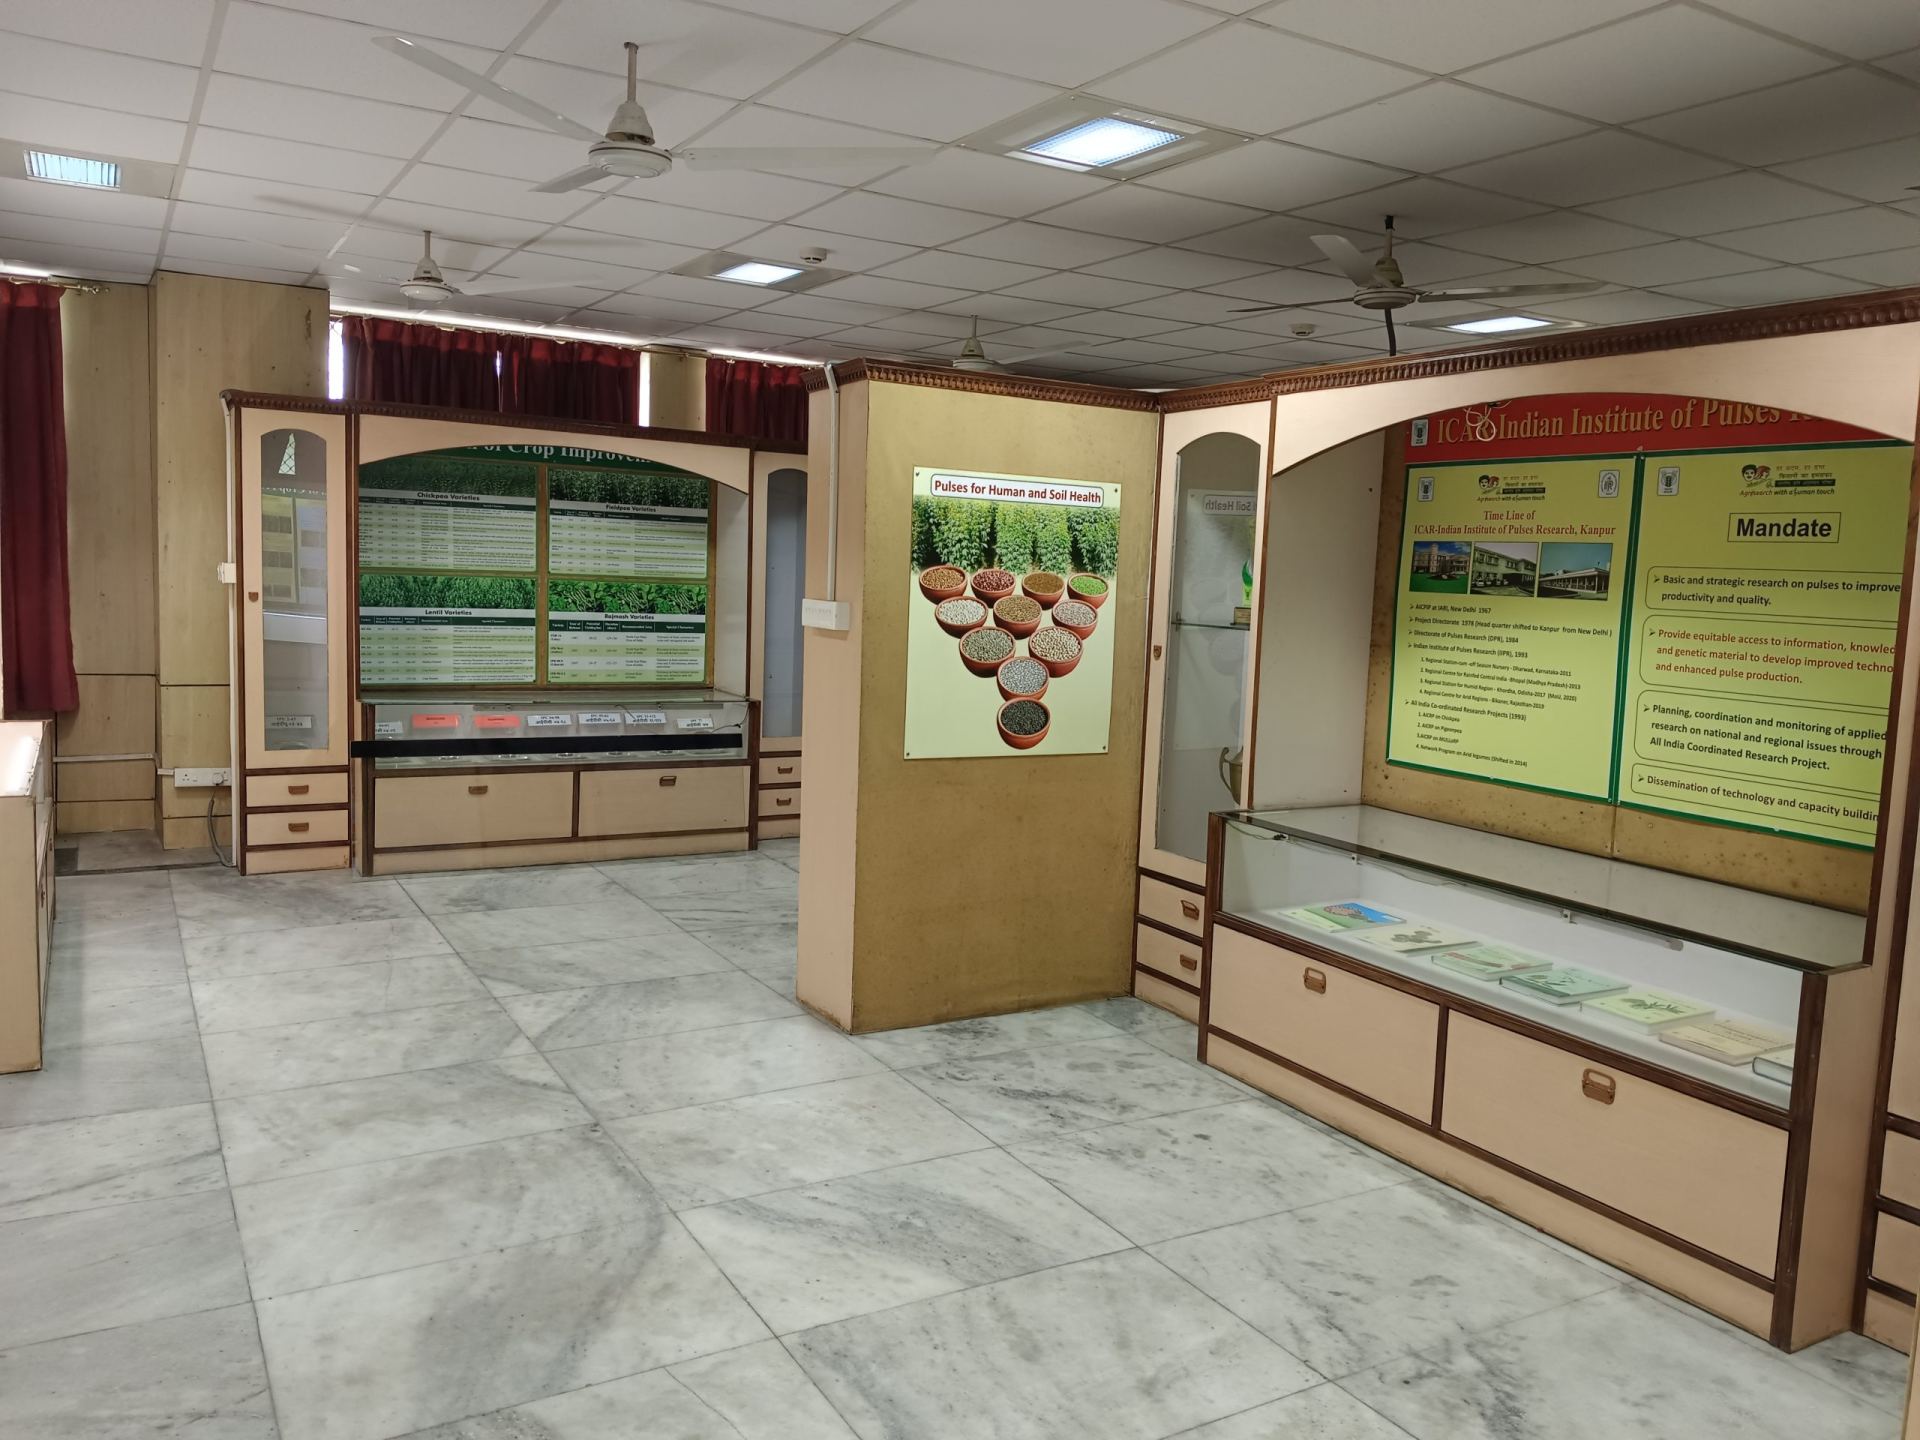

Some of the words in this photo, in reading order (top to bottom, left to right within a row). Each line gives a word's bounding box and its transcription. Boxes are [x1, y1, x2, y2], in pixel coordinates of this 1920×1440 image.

[1570, 404, 1666, 435] Institute
[1671, 399, 1696, 428] of
[1702, 400, 1781, 426] Pulses
[416, 491, 448, 499] Chickpea
[935, 480, 968, 493] Pulses
[971, 482, 986, 494] for
[989, 485, 1025, 497] Human
[1028, 487, 1047, 499] and
[1049, 489, 1067, 501] Soil
[1070, 491, 1101, 503] Health
[1484, 510, 1504, 520] Time
[1506, 510, 1524, 520] Line
[1526, 510, 1536, 520] of
[1414, 525, 1462, 534] ICAR-Indian
[1464, 525, 1496, 534] Institute
[1498, 525, 1508, 534] of
[1508, 525, 1534, 534] Pulses
[1536, 525, 1578, 535] Research,
[1580, 525, 1616, 537] Kanpur
[1737, 518, 1832, 537] Mandate
[1663, 575, 1685, 584] Basic
[1687, 575, 1704, 585] and
[1706, 577, 1745, 588] strategic
[1747, 578, 1788, 588] research
[1806, 580, 1839, 591] pulses
[1842, 582, 1853, 590] to
[1856, 582, 1902, 594] improve
[1662, 592, 1715, 603] productivity
[1717, 594, 1734, 603] and
[1737, 595, 1771, 606] quality.
[1659, 629, 1691, 639] Provide
[1693, 631, 1736, 643] equitable
[1738, 636, 1768, 645] access
[1771, 638, 1781, 646] to
[1784, 637, 1847, 651] information,
[1657, 645, 1673, 655] and
[1675, 647, 1707, 659] genetic
[1709, 649, 1748, 661] material
[1750, 654, 1760, 662] to
[1762, 653, 1802, 666] develop
[1804, 657, 1854, 670] improved
[1857, 659, 1894, 673] techno
[1656, 662, 1672, 671] and
[1674, 663, 1717, 676] enhanced
[1719, 667, 1744, 680] pulse
[1746, 670, 1802, 684] production.
[1653, 704, 1692, 719] Planning,
[1695, 709, 1753, 724] coordination
[1755, 716, 1774, 727] and
[1776, 719, 1832, 736] monitoring
[1834, 725, 1846, 736] of
[1652, 721, 1688, 733] research
[1704, 727, 1741, 740] national
[1744, 732, 1762, 743] and
[1764, 735, 1804, 750] regional
[1807, 740, 1837, 753] issues
[1840, 744, 1882, 761] through
[1650, 736, 1662, 746] All
[1664, 738, 1685, 750] India
[1687, 742, 1743, 758] Coordinated
[1745, 750, 1788, 764] Research
[1791, 756, 1830, 772] Project.
[1647, 775, 1708, 793] Dissemination
[1711, 785, 1720, 796] of
[1722, 788, 1775, 806] technology
[1778, 796, 1796, 808] and
[1798, 801, 1840, 817] capacity
